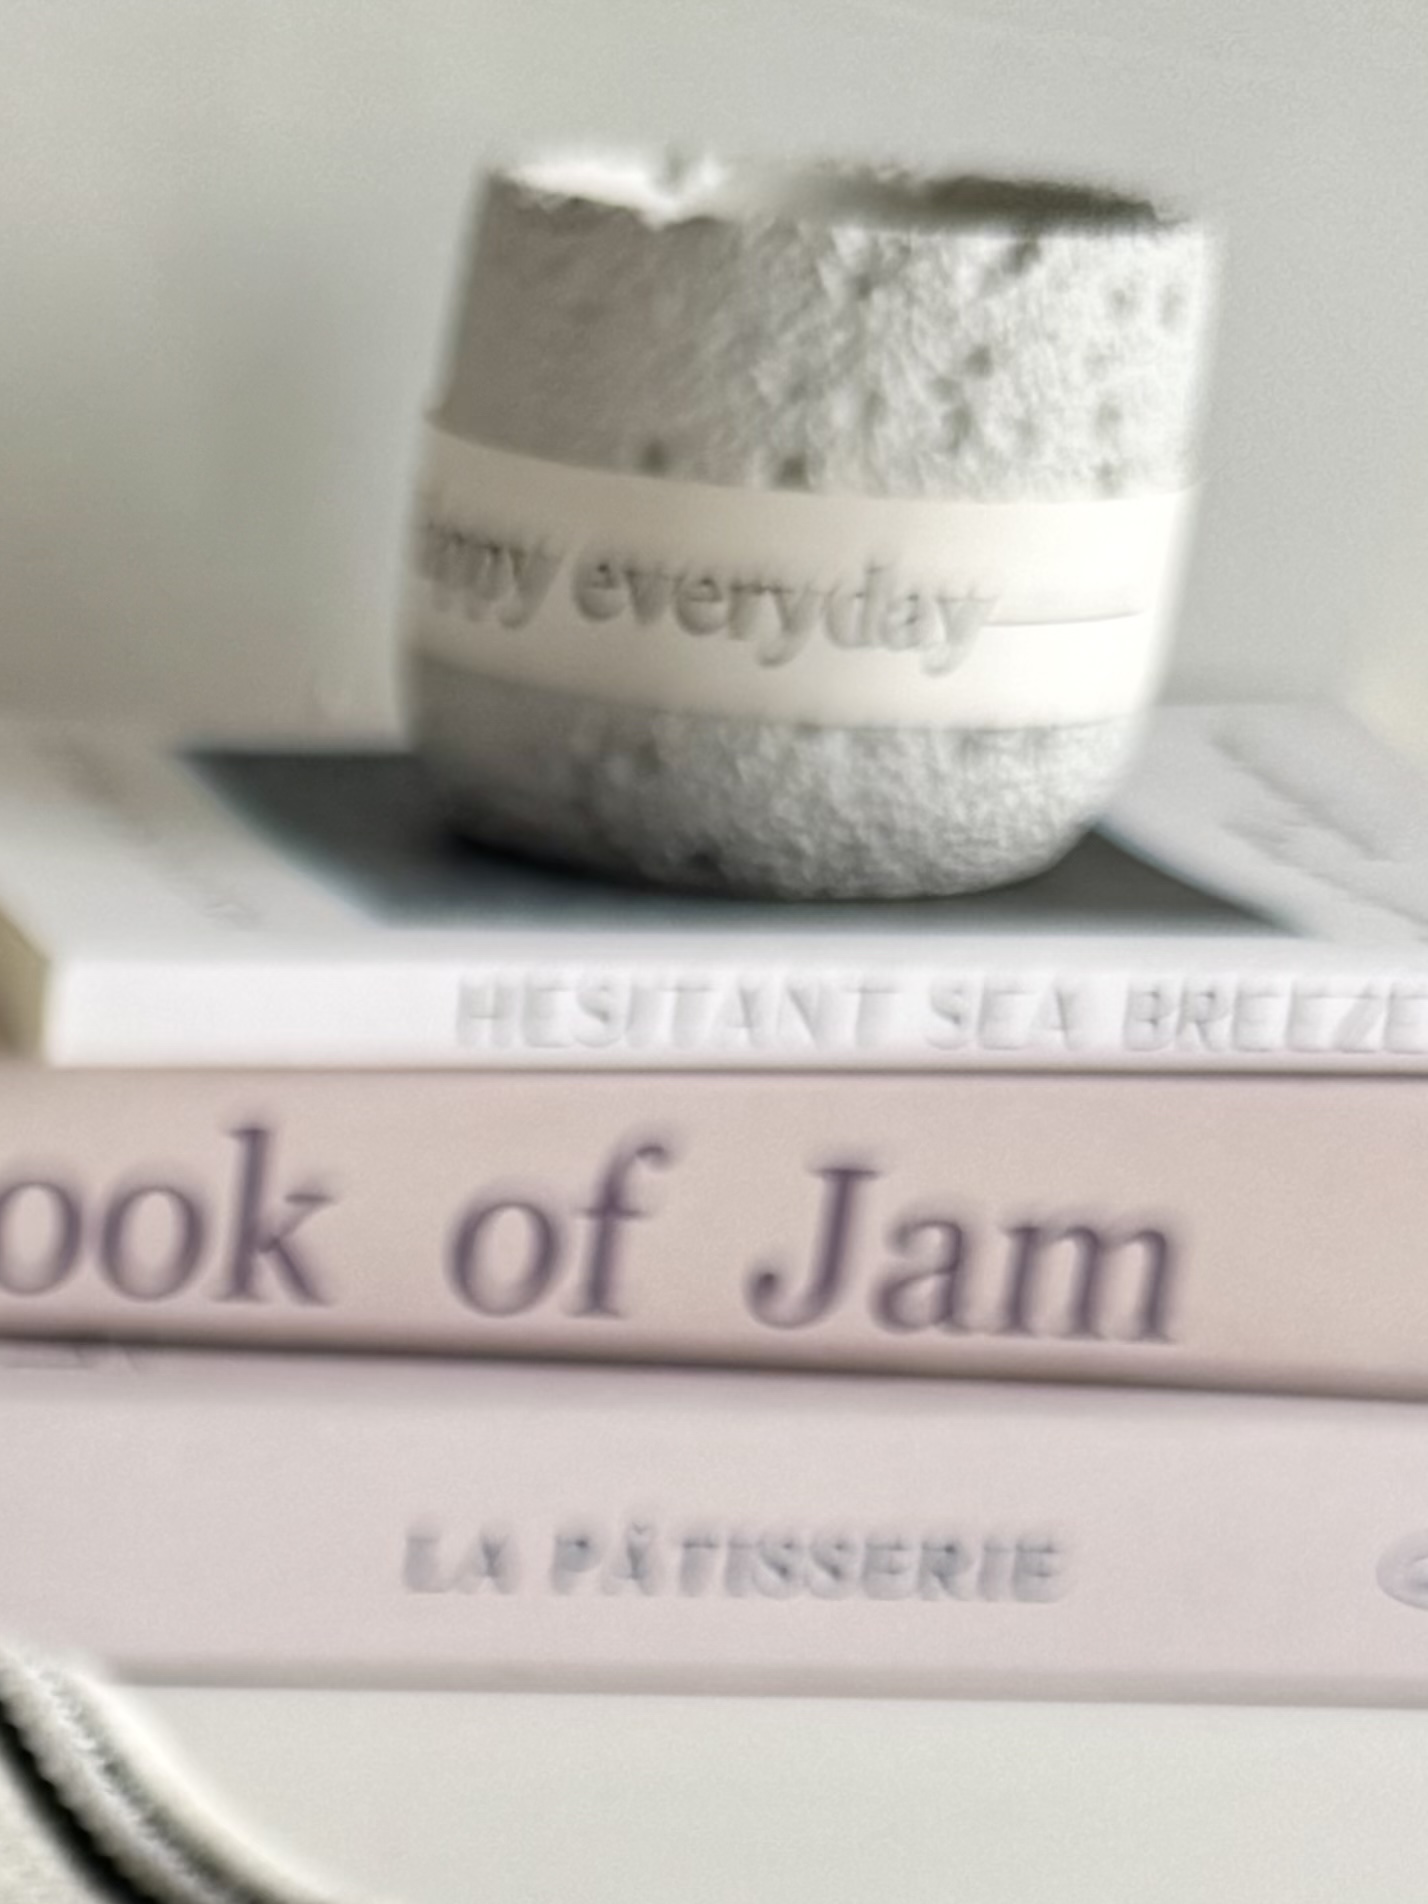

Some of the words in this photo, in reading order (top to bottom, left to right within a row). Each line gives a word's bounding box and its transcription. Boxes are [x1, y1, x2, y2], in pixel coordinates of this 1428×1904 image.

[569, 550, 999, 678] everyday
[454, 976, 901, 1050] HESITANT
[924, 976, 1094, 1052] SEA
[446, 1126, 674, 1322] of
[742, 1150, 1186, 1346] Jam
[400, 1533, 514, 1596] LA
